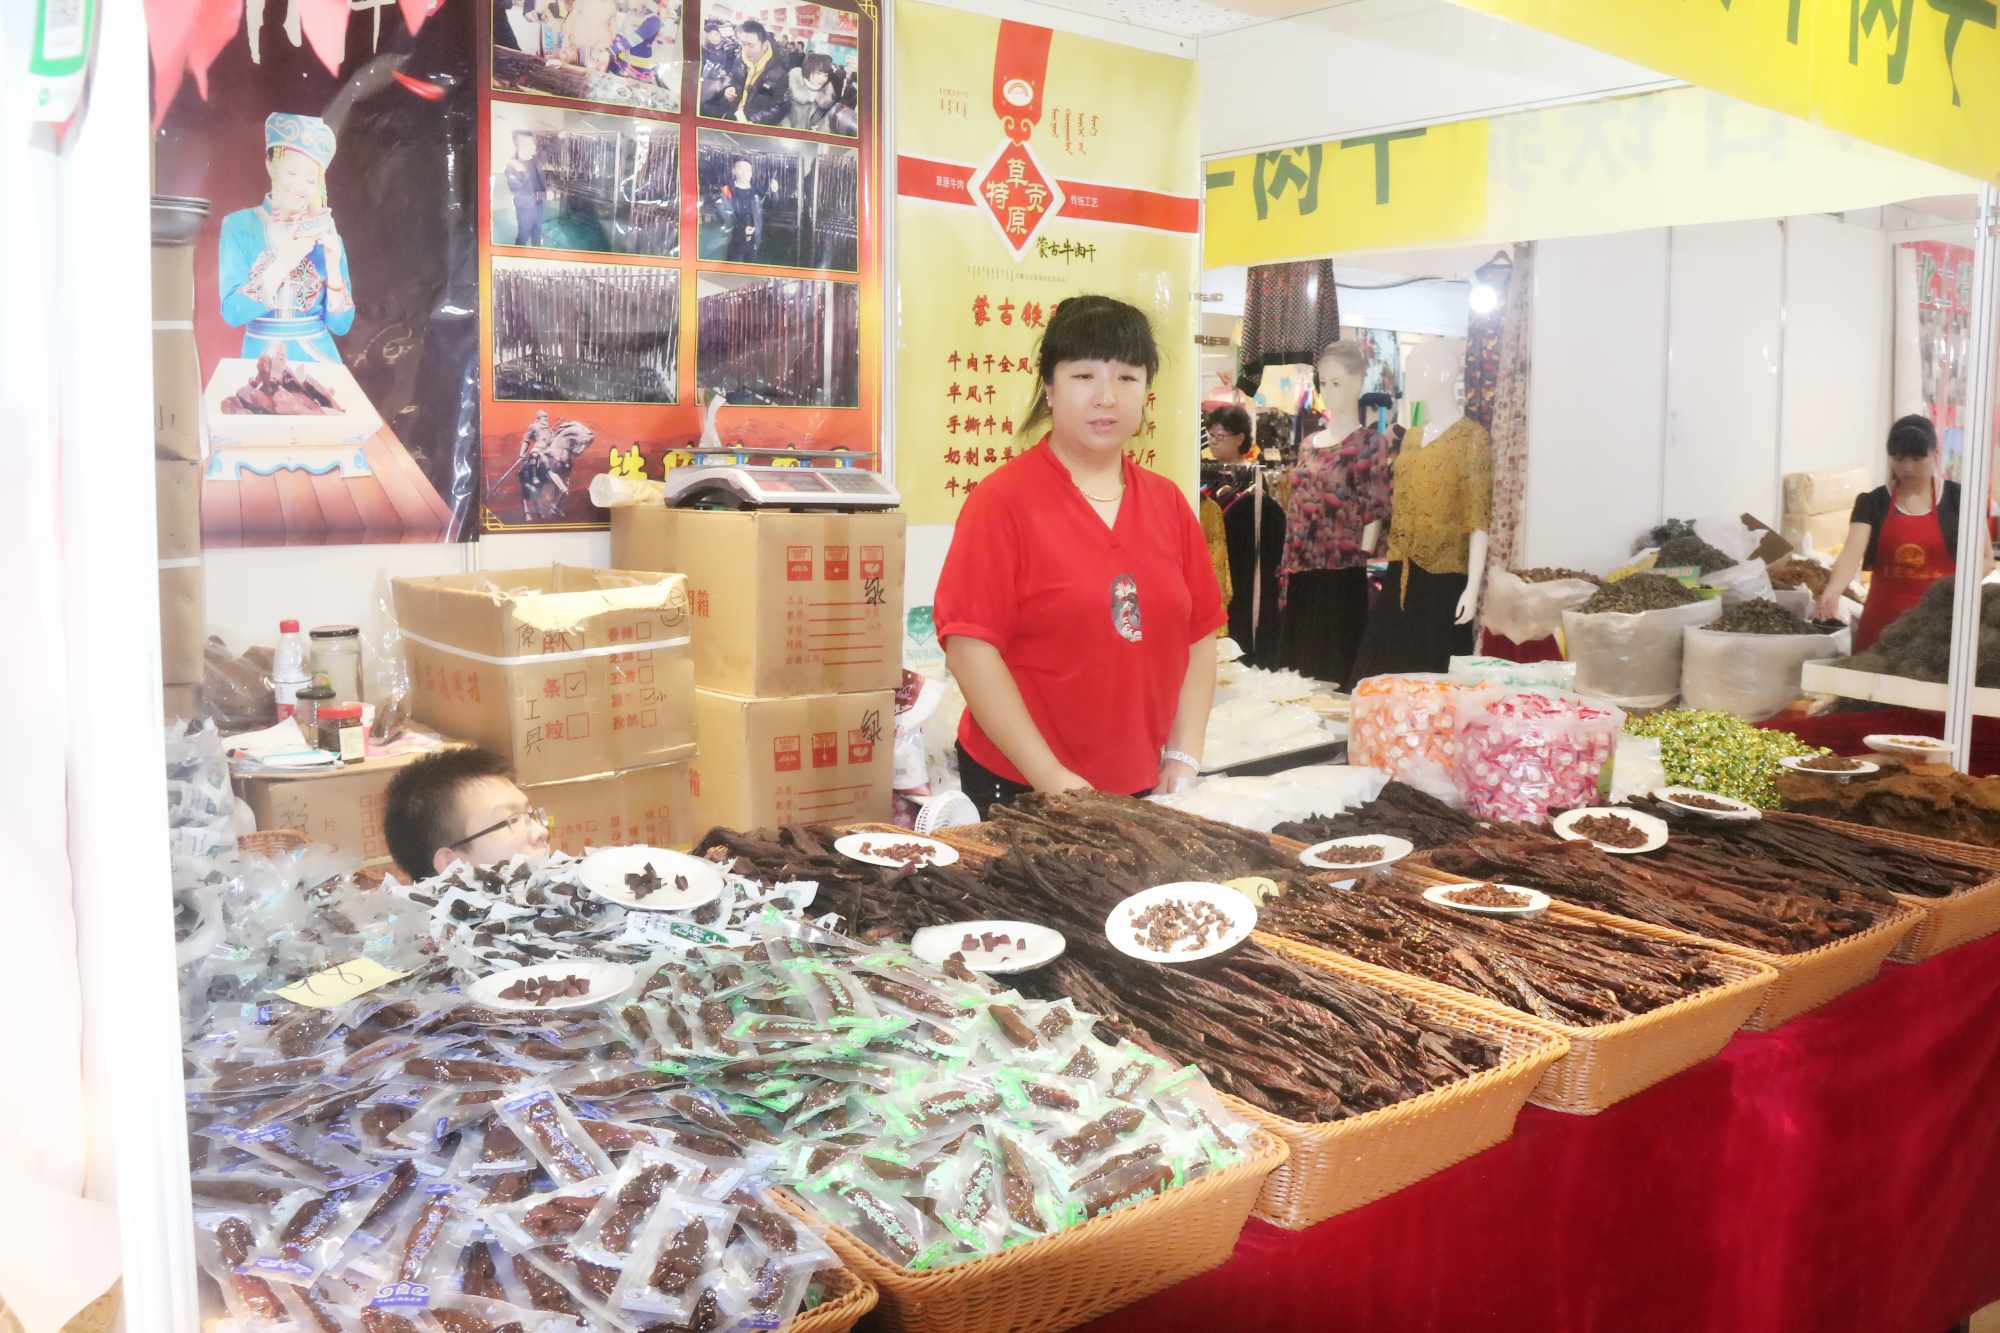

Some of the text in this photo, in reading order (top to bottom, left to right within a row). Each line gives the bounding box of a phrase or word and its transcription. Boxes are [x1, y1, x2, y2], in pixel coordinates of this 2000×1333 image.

[1037, 236, 1097, 265] 蒙古牛肉干
[946, 414, 1013, 437] 手撕牛肉
[944, 446, 1025, 467] 奶制品单
